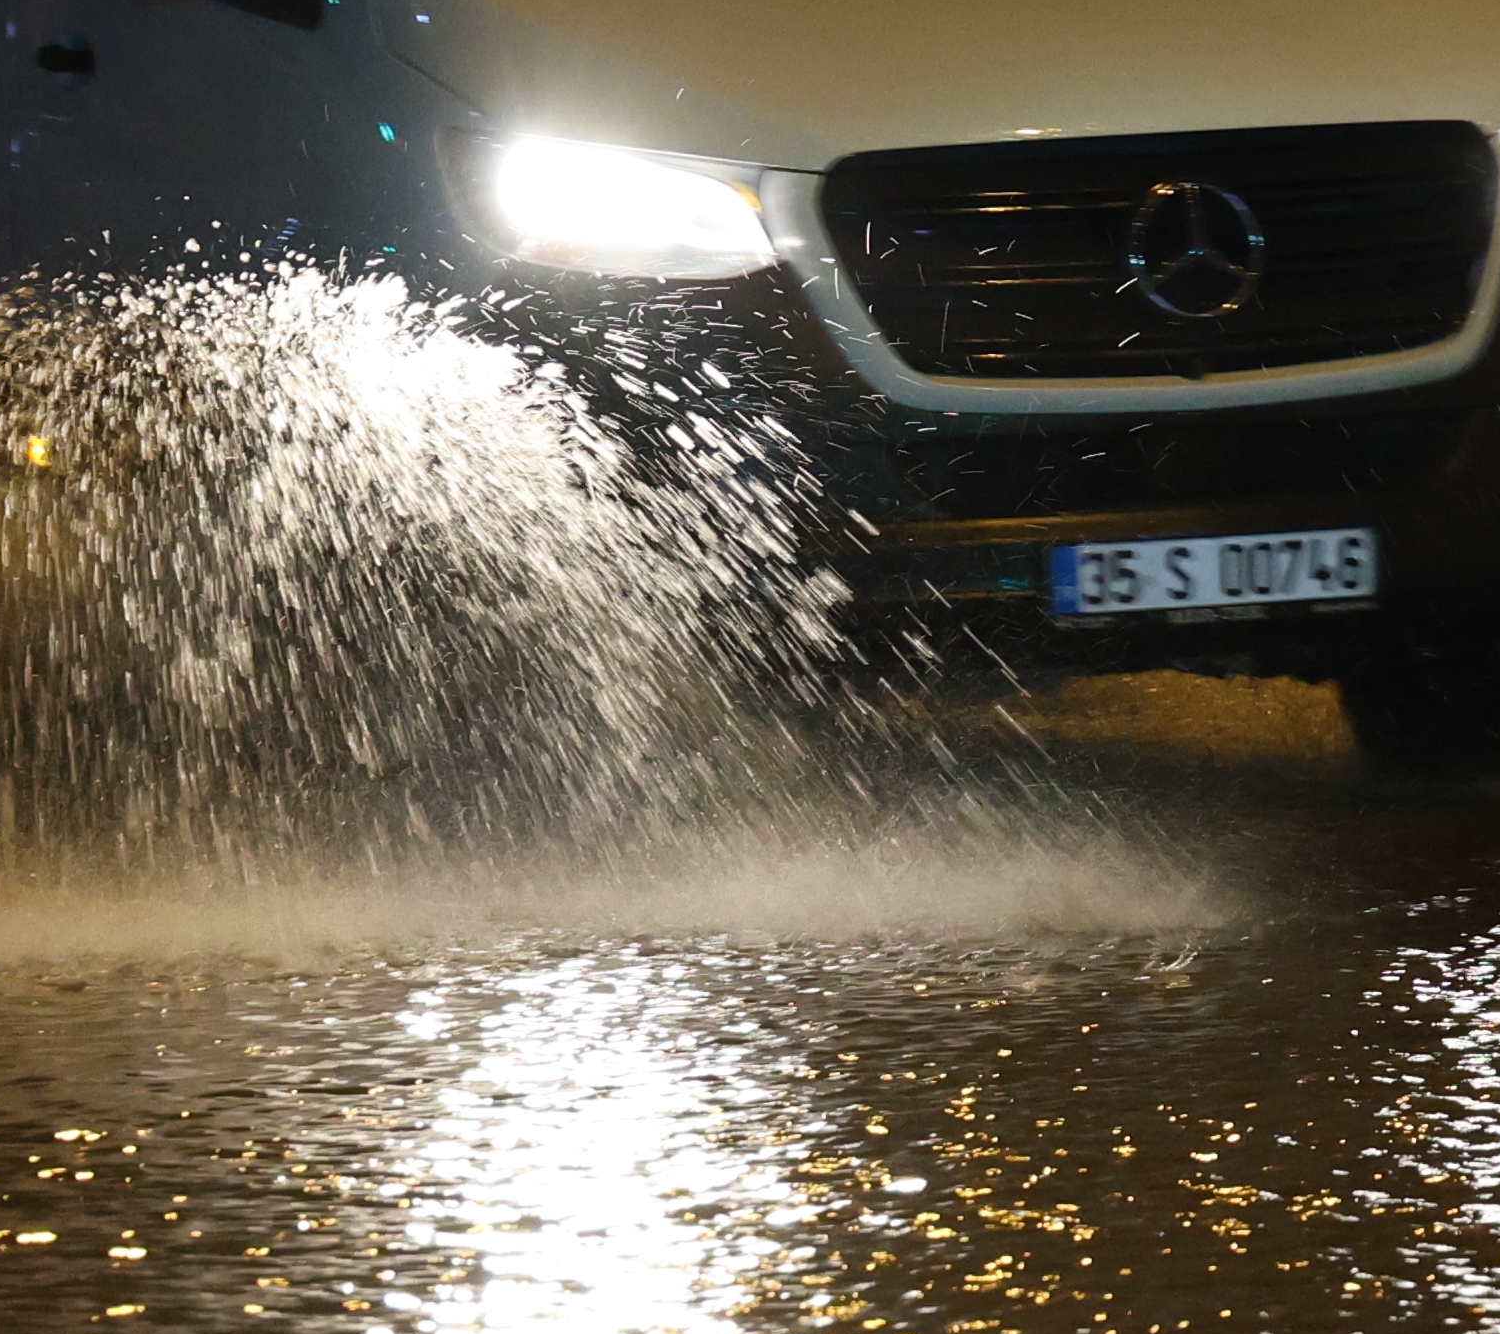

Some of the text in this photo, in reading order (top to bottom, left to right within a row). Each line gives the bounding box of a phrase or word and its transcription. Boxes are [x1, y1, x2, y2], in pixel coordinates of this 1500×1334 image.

[1082, 535, 1368, 605] 35 S 00746
